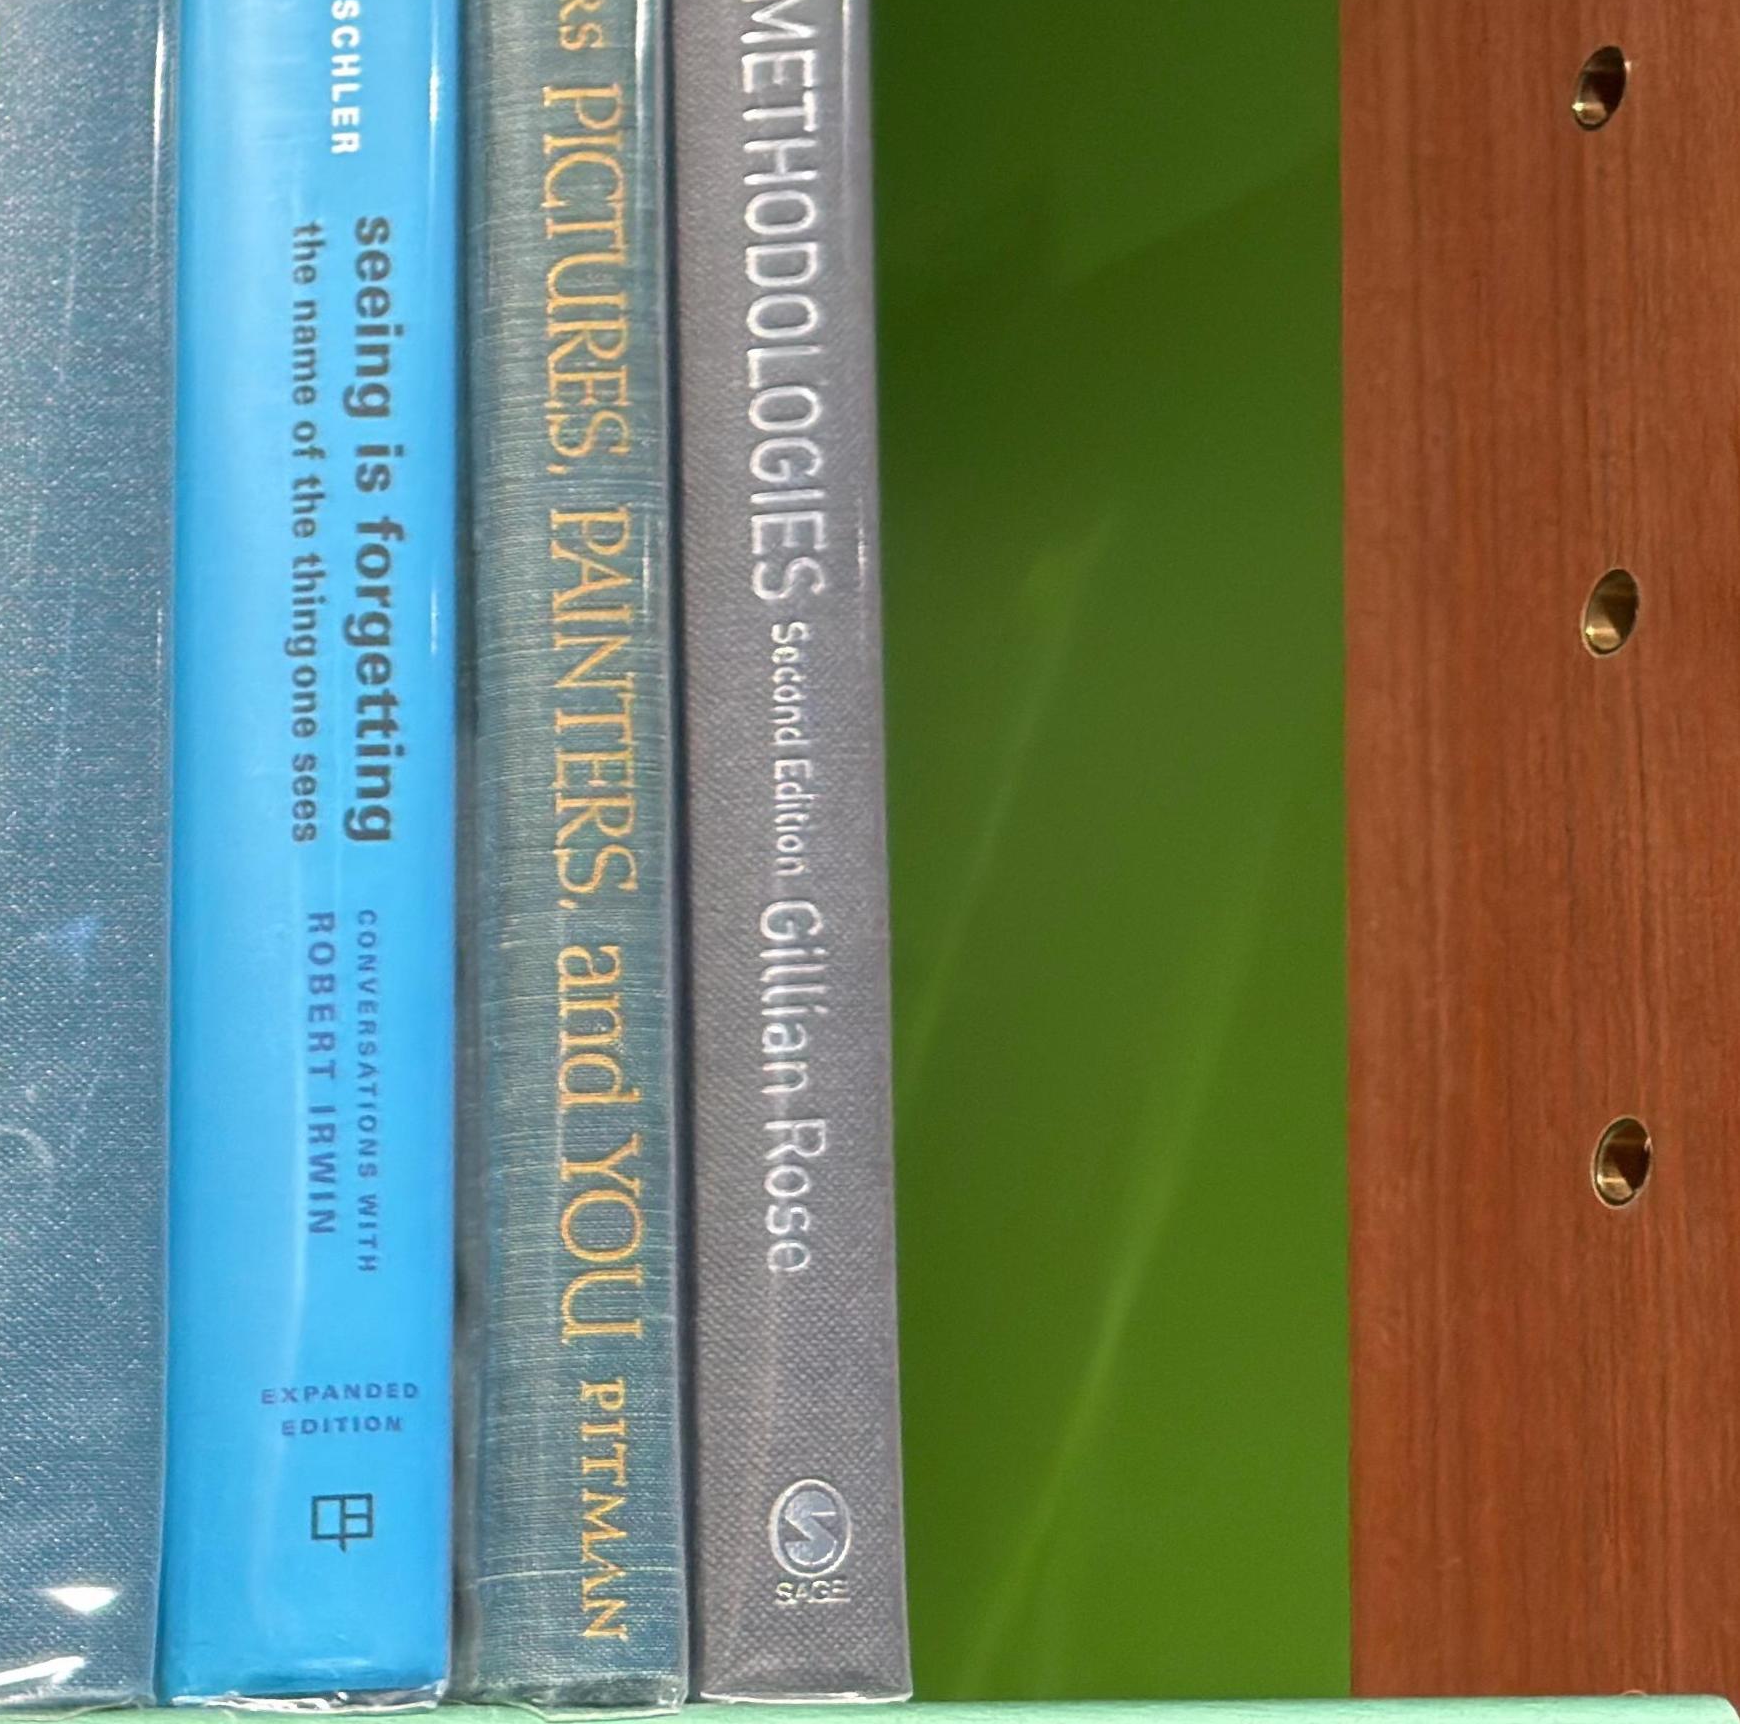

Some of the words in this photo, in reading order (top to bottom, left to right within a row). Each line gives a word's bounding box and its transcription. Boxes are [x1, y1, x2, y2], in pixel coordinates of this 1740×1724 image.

[343, 215, 405, 418] seeing
[542, 82, 630, 476] PICTURES,
[355, 444, 406, 493] is
[343, 518, 406, 842] forgetting
[546, 505, 638, 911] PAINTERS,
[554, 943, 643, 1113] and
[557, 1132, 644, 1345] YOU
[261, 1381, 418, 1405] EXPANDED
[280, 1415, 403, 1436] EDITION
[578, 1381, 630, 1640] PITMAN
